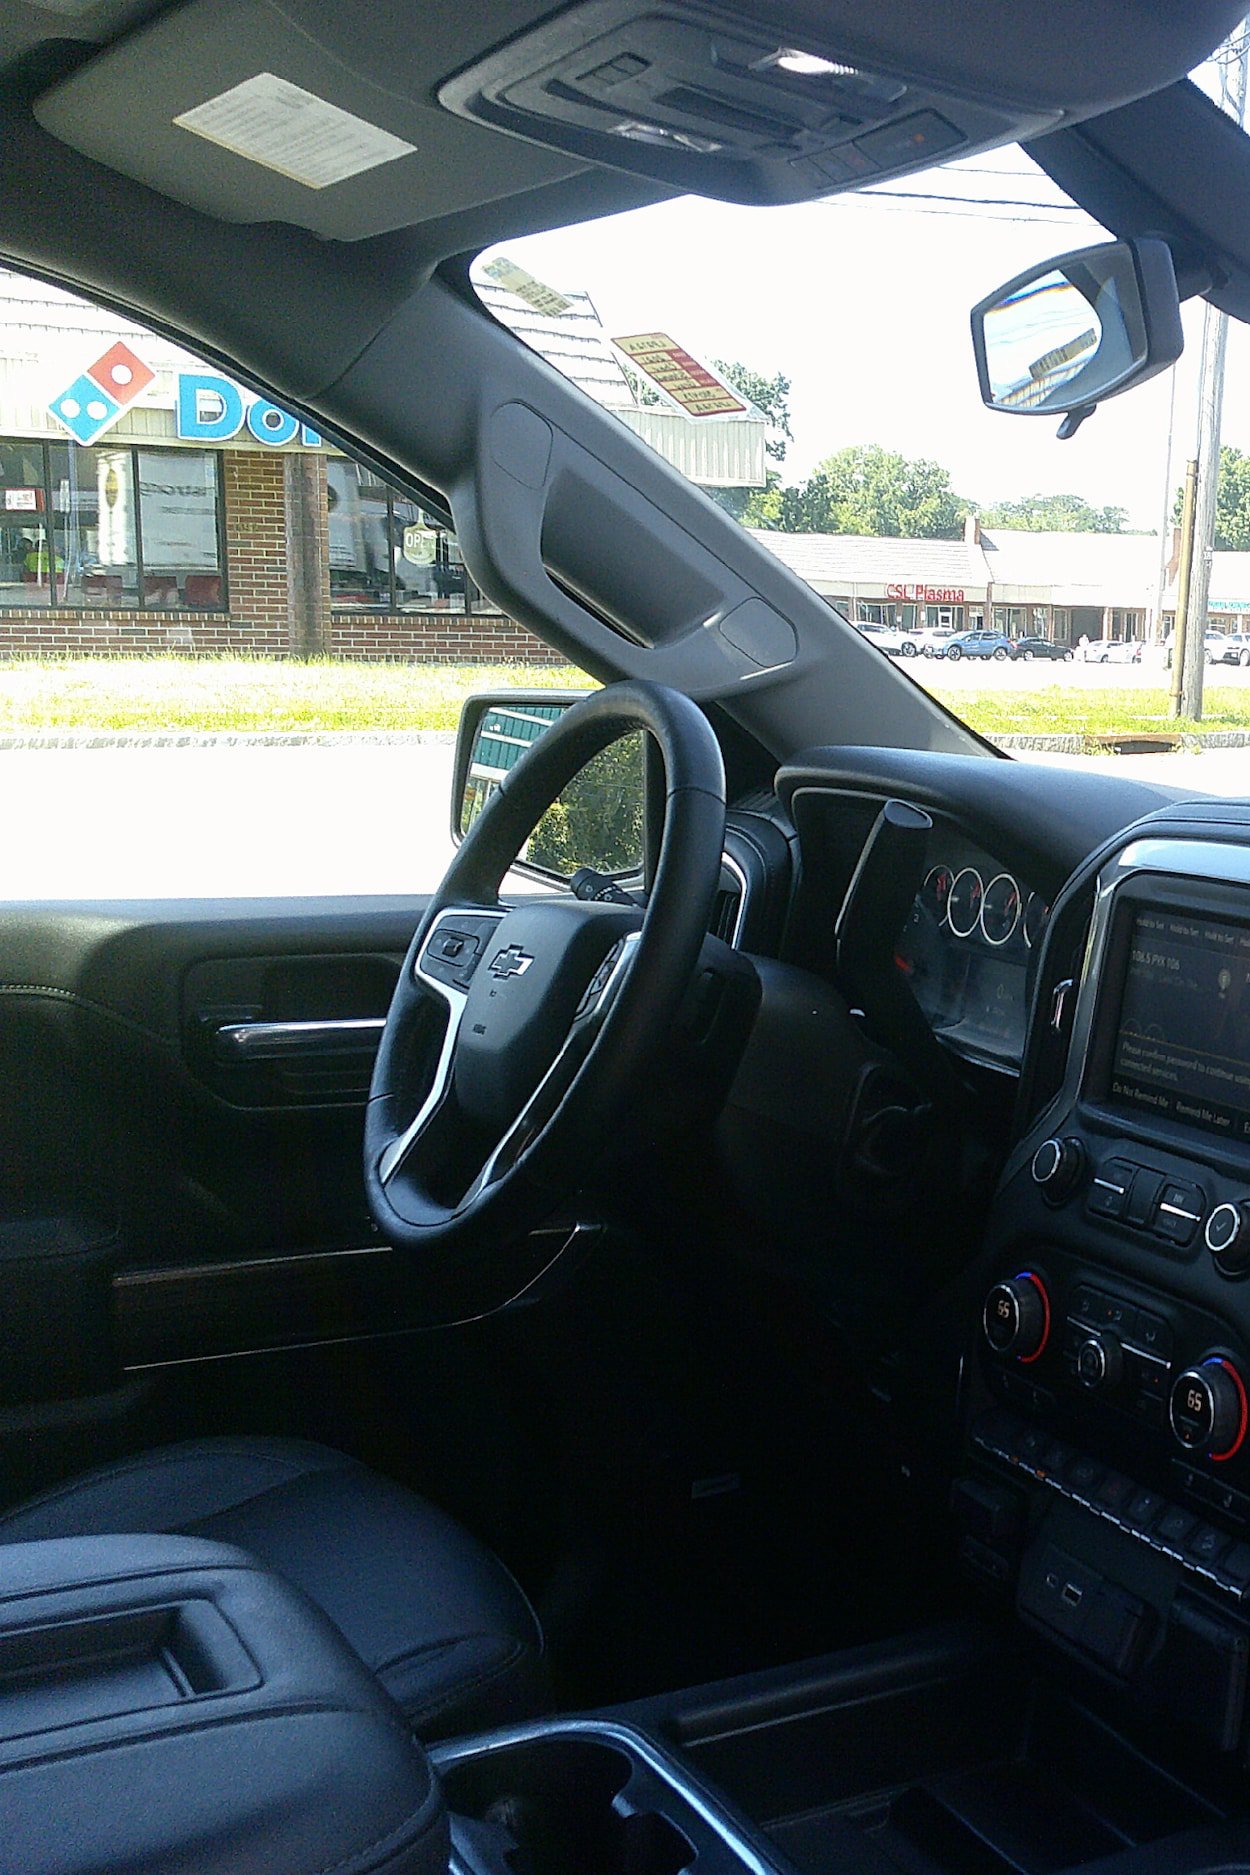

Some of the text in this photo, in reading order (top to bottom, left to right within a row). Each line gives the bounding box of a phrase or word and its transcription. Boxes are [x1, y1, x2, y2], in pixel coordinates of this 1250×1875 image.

[887, 584, 965, 602] CSL Plasma
[1186, 1389, 1203, 1412] 65
